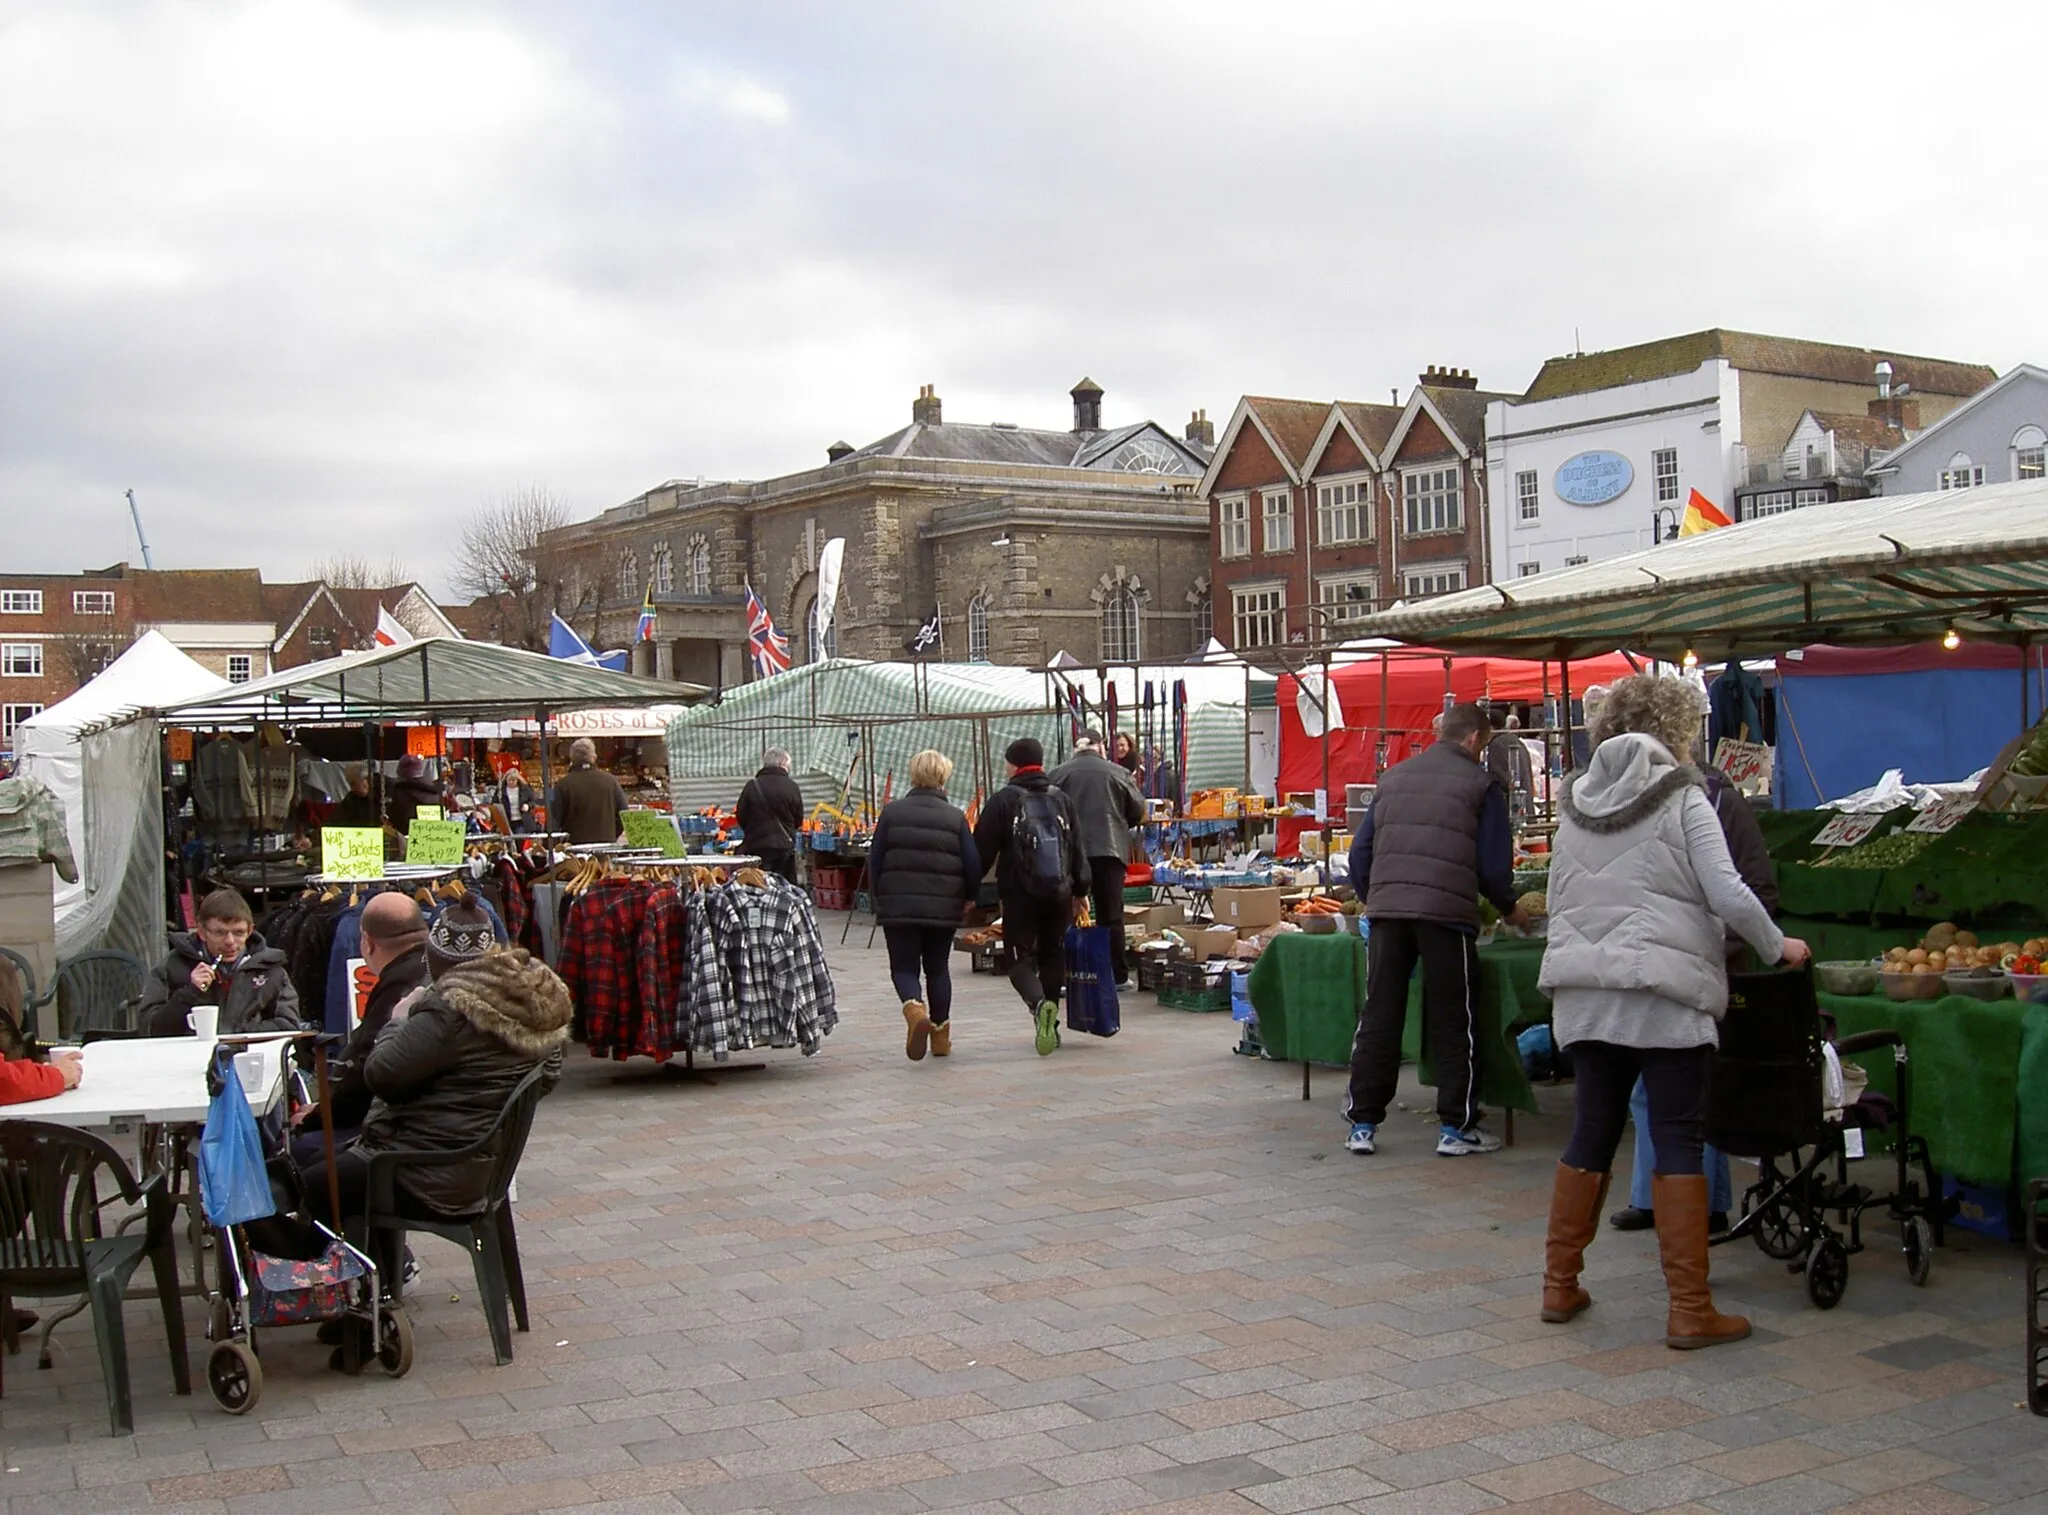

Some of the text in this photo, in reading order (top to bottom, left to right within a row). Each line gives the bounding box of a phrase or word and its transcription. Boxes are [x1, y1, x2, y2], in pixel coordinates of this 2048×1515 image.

[1563, 460, 1622, 482] DUCHESS
[1567, 479, 1620, 501] ALBANY
[559, 711, 624, 730] ROSES
[631, 712, 647, 728] of
[324, 831, 344, 849] Wolf
[340, 838, 381, 859] Jackets
